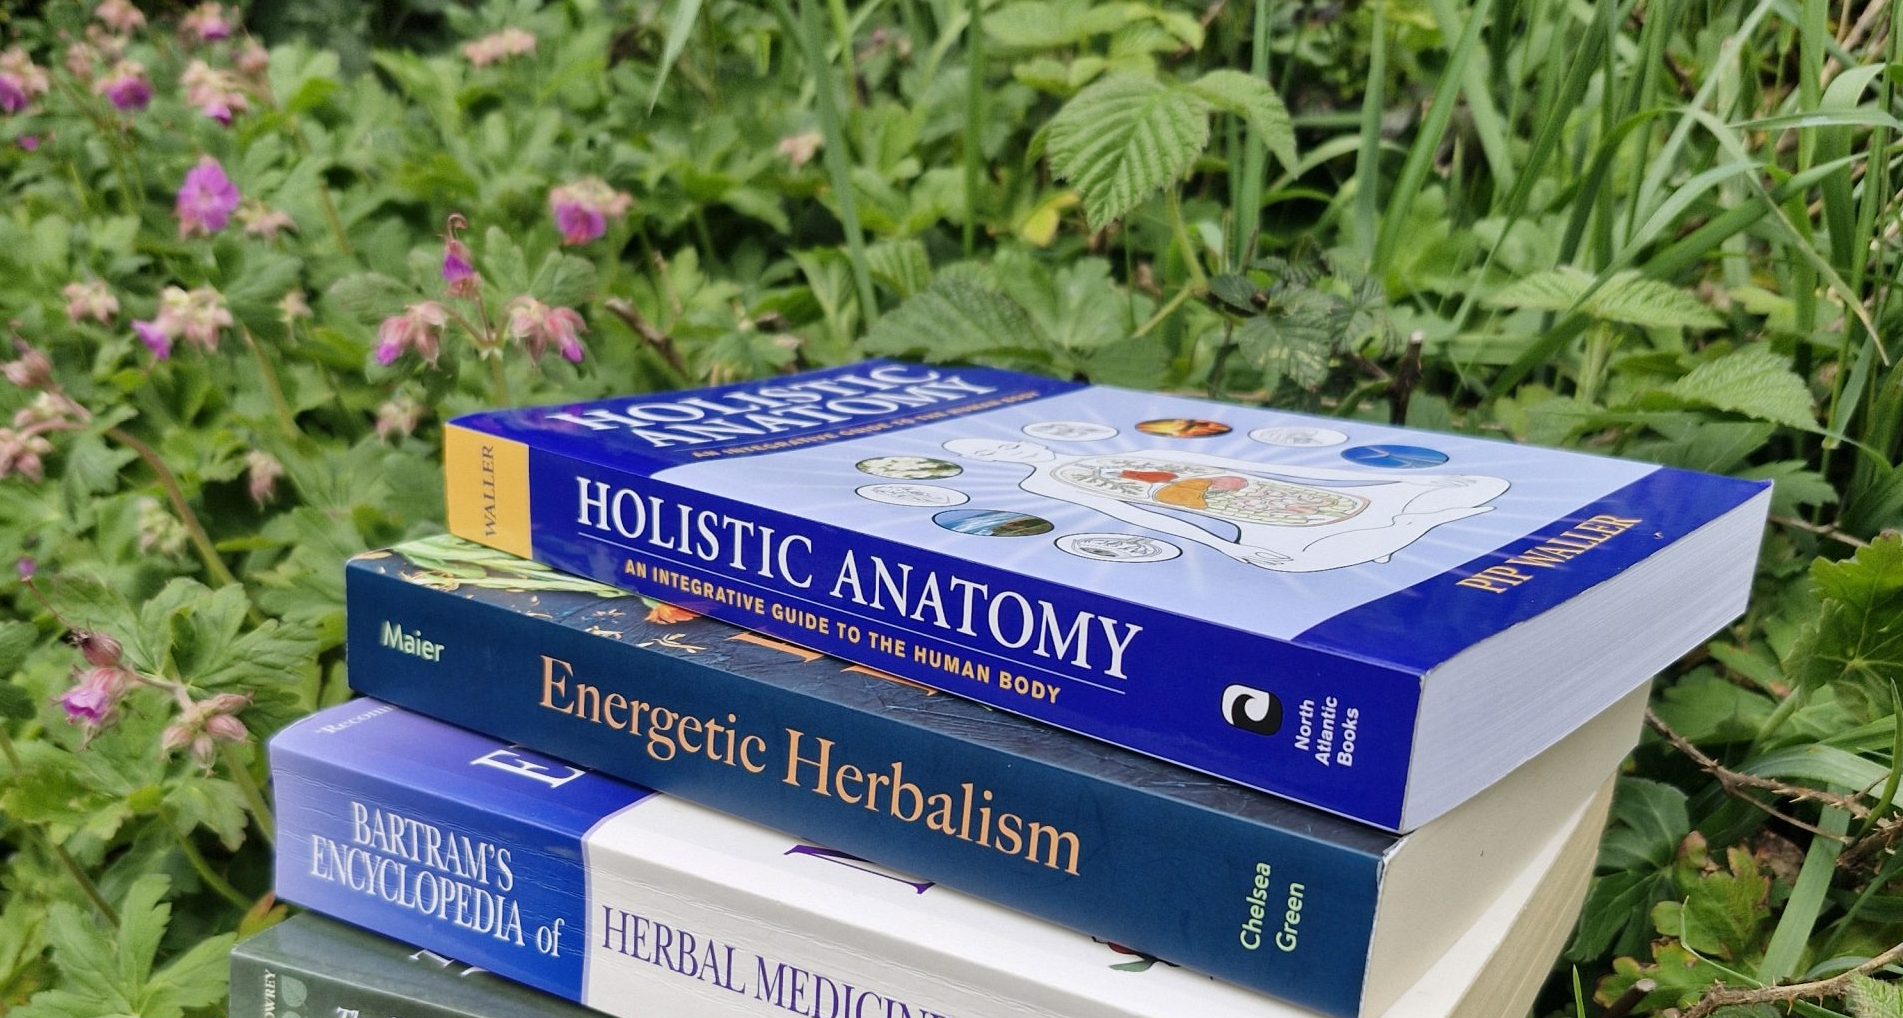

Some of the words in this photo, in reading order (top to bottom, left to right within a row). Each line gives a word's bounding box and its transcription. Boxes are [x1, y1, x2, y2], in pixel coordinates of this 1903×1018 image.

[546, 364, 940, 431] HOLISTIC
[630, 375, 998, 449] ANATOMY
[482, 445, 497, 537] WALLER
[576, 476, 813, 589] HOLISTIC
[829, 549, 1143, 680] ANATOMY
[1455, 565, 1534, 594] PIP
[1504, 514, 1643, 568] WALLER
[380, 620, 445, 663] Maier
[624, 559, 647, 579] AN
[652, 566, 766, 615] INTEGRATIVE
[771, 603, 829, 636] GUIDE
[836, 622, 861, 644] TO
[868, 632, 907, 658] THE
[914, 645, 990, 684] HUMAN
[999, 670, 1062, 704] BODY
[538, 654, 768, 775] Energetic
[782, 727, 1081, 877] Herbalism
[1294, 699, 1315, 751] North
[1314, 696, 1338, 767] Atlantic
[1336, 707, 1359, 767] Books
[351, 801, 514, 892] BARTRAM'S
[310, 834, 526, 947] ENCYCLOPEDIA
[536, 917, 566, 958] of
[1239, 862, 1271, 950] Chelsea
[1275, 882, 1305, 952] Green
[601, 905, 746, 994] HERBAL
